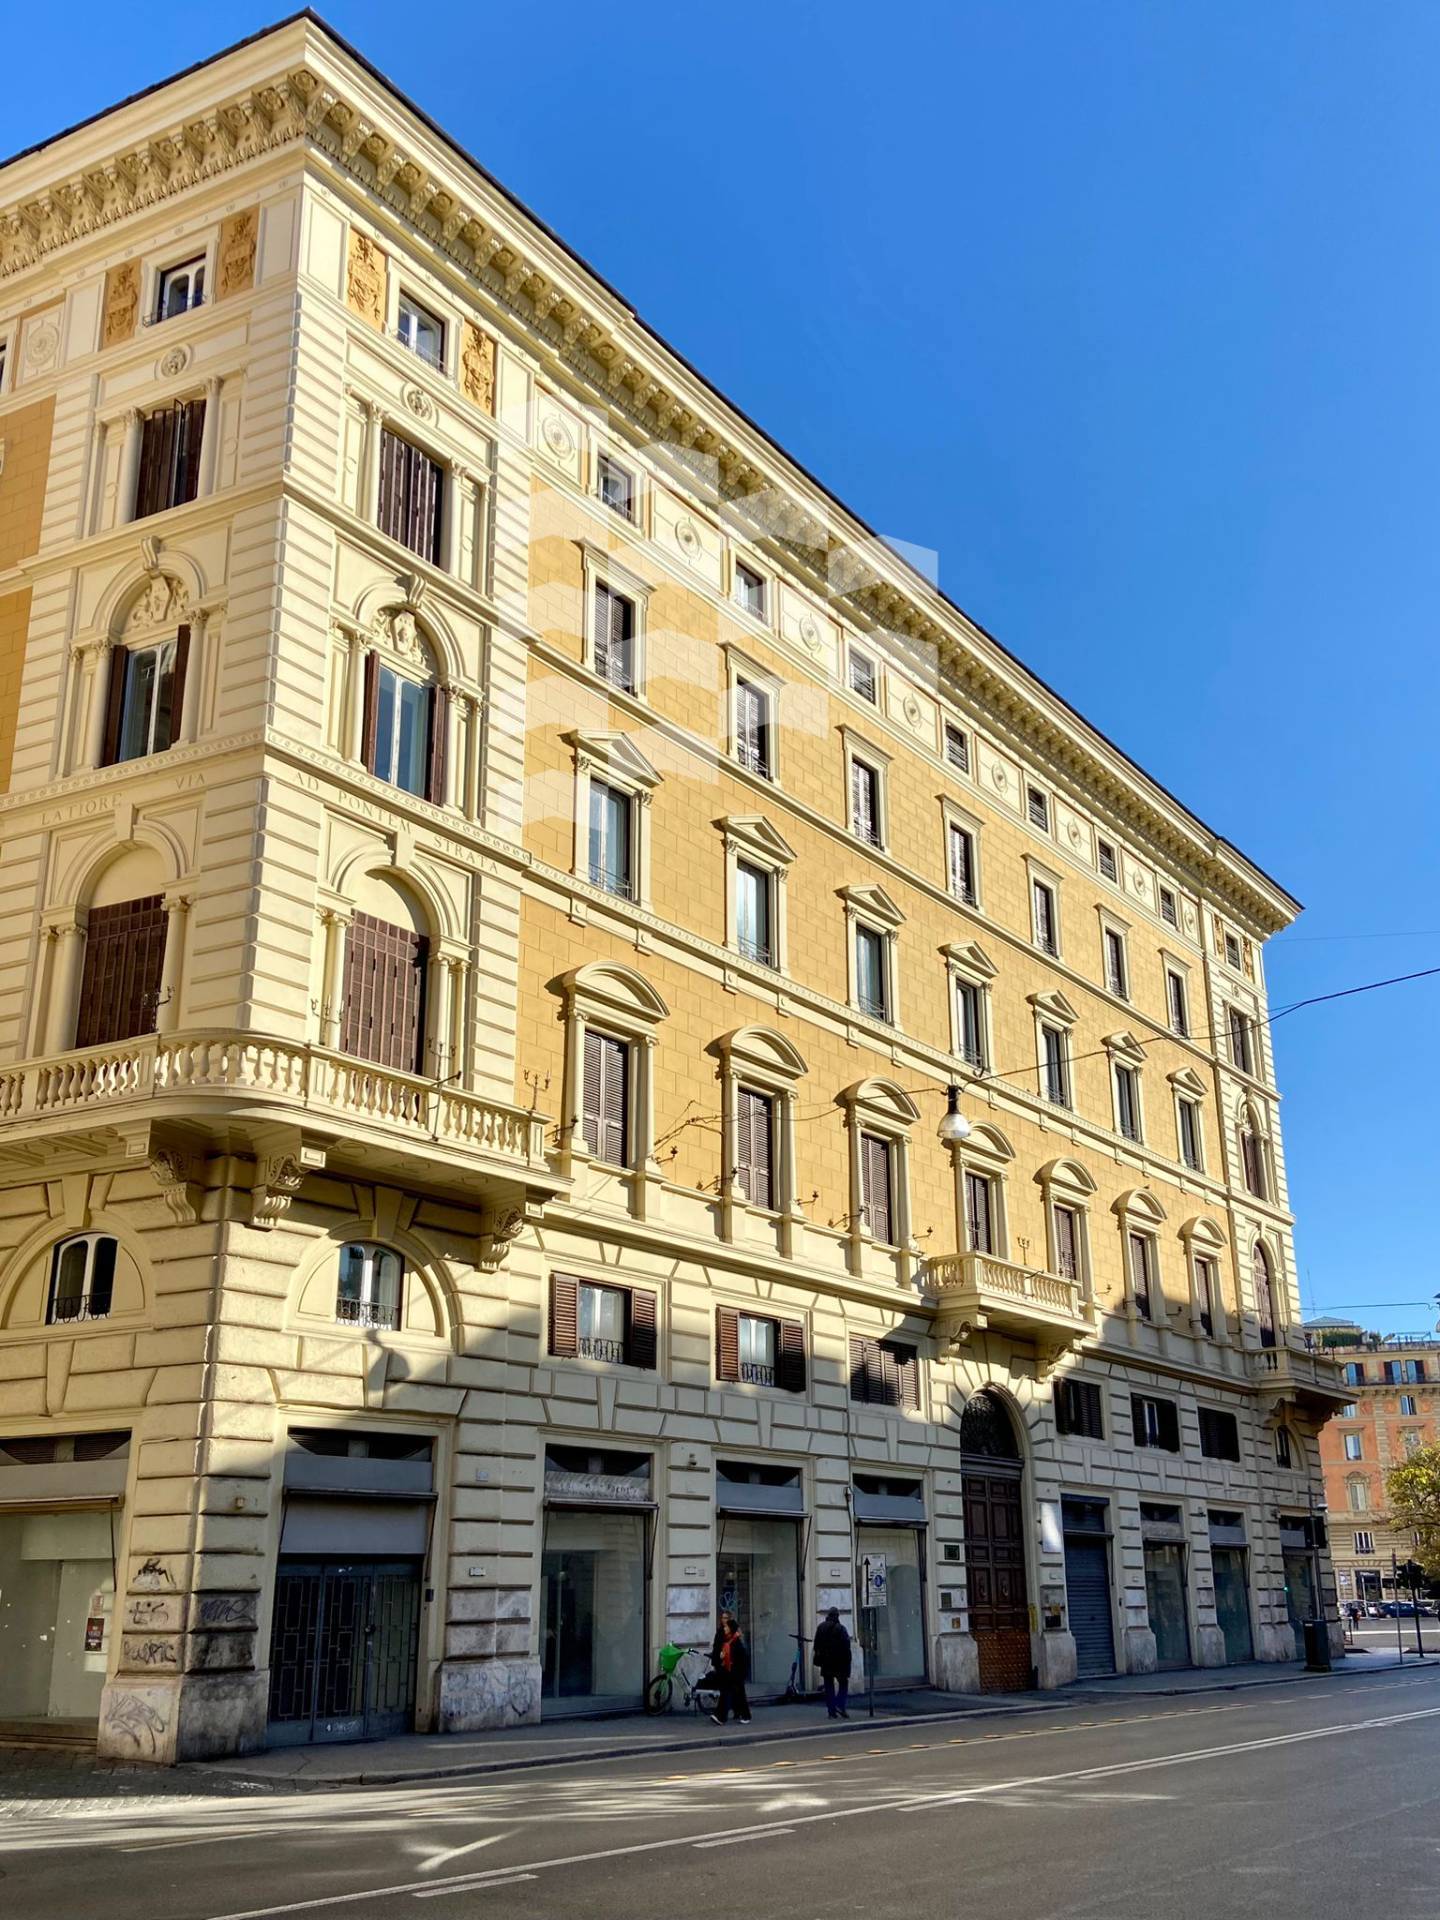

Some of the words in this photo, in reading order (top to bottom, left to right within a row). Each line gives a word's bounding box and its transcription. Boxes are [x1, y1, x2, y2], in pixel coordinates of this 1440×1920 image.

[40, 792, 124, 826] LATIORE
[175, 773, 206, 790] VIA
[293, 771, 320, 792] AD
[337, 790, 412, 835] PONTEM
[433, 835, 499, 875] STRATA
